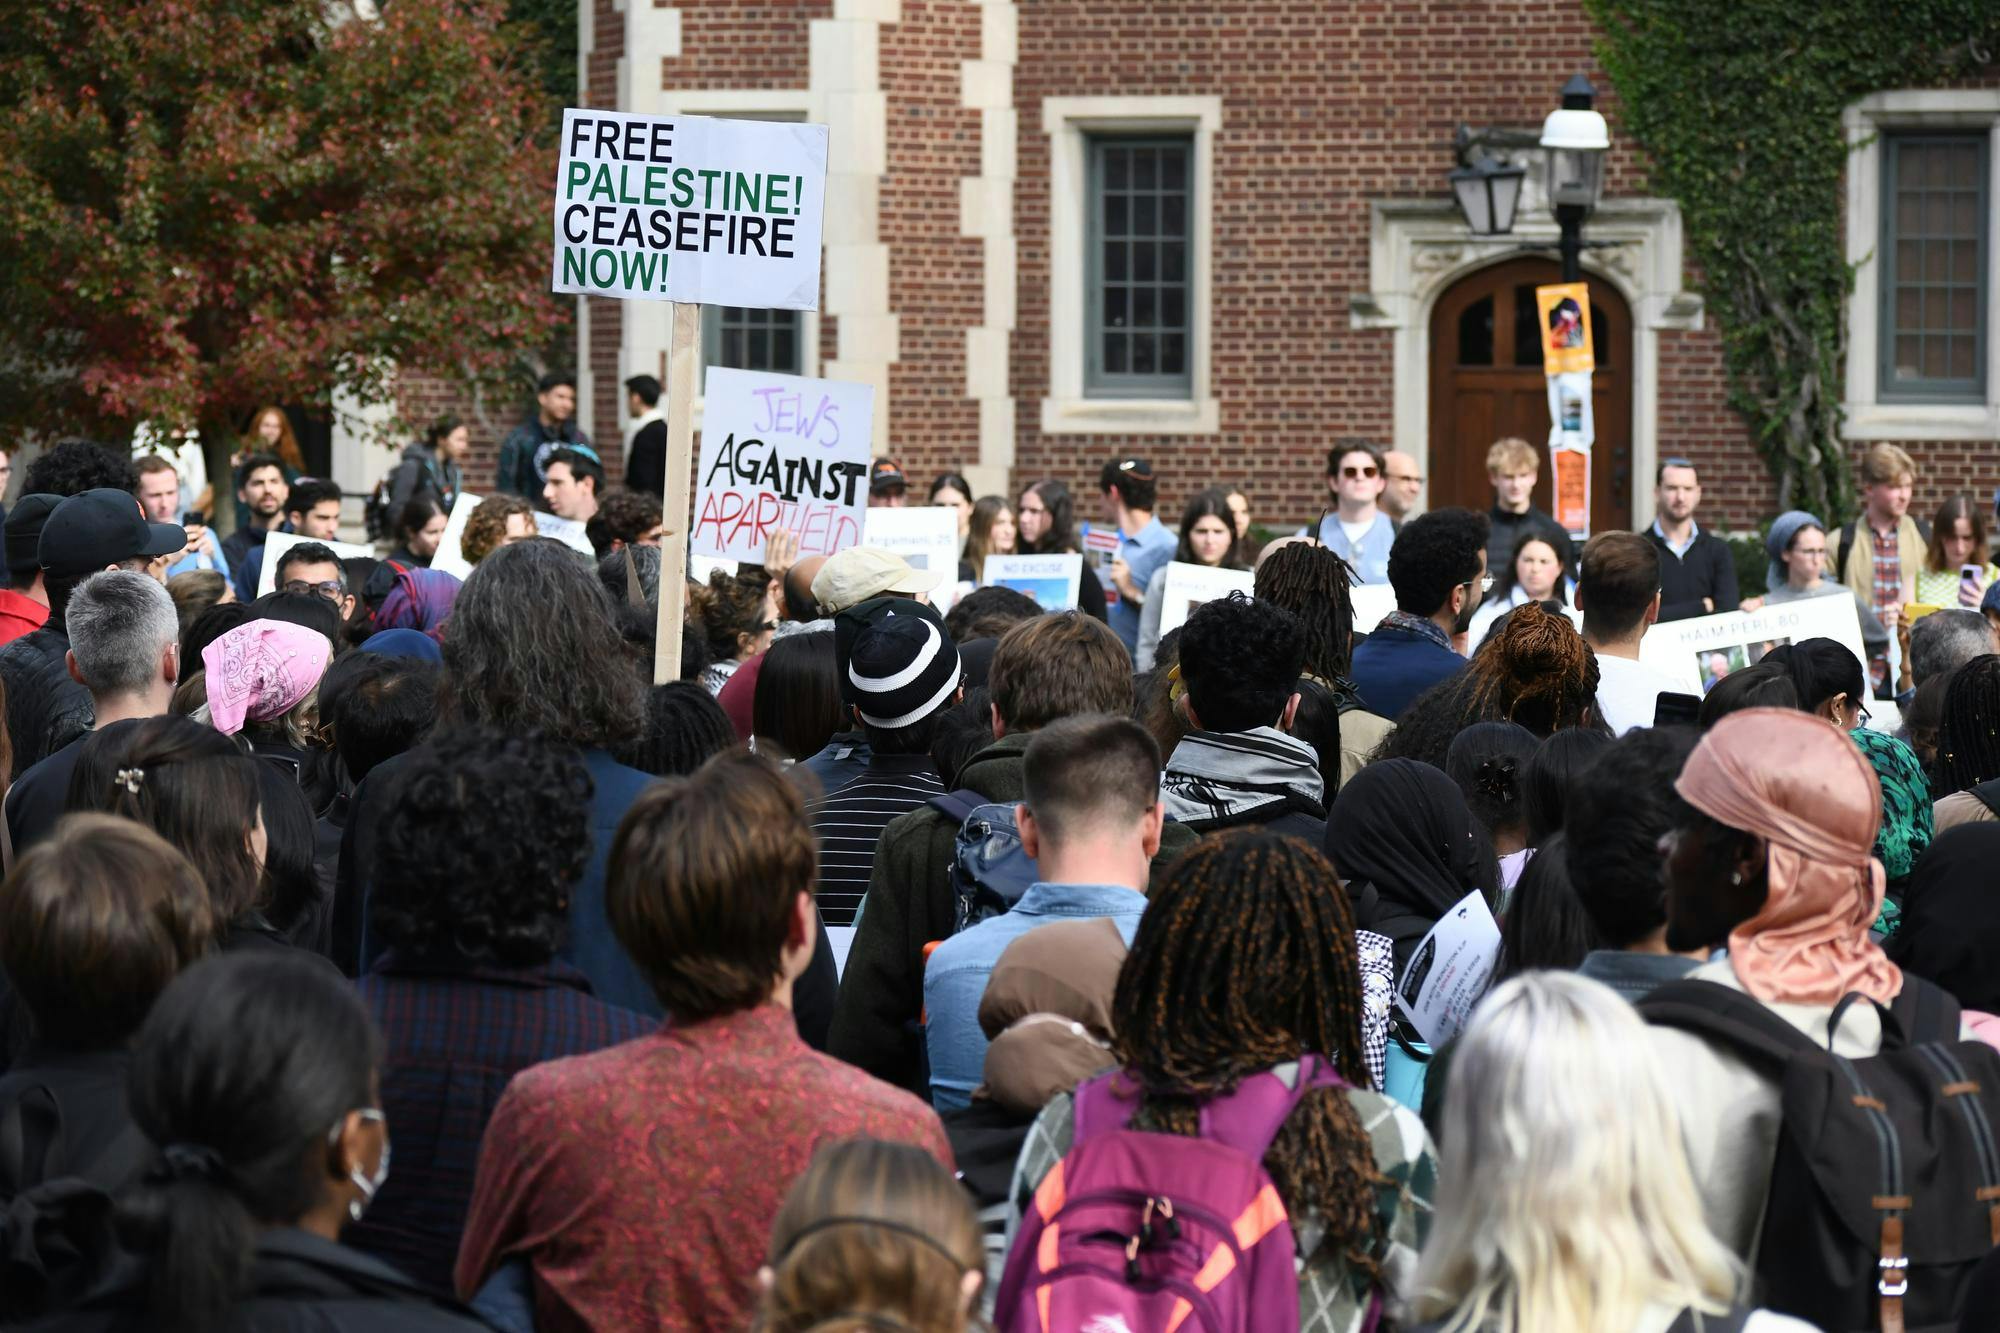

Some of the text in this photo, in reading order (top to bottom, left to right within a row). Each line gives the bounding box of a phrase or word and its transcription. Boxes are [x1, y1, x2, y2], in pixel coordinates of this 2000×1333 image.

[570, 118, 674, 163] FREE
[566, 160, 803, 215] PALESTINE!
[563, 204, 795, 258] CEASEFIRE
[563, 247, 668, 293] NOW!
[752, 387, 840, 448] JEWS
[705, 433, 867, 507] AGAINST
[1680, 625, 1724, 642] HAIM
